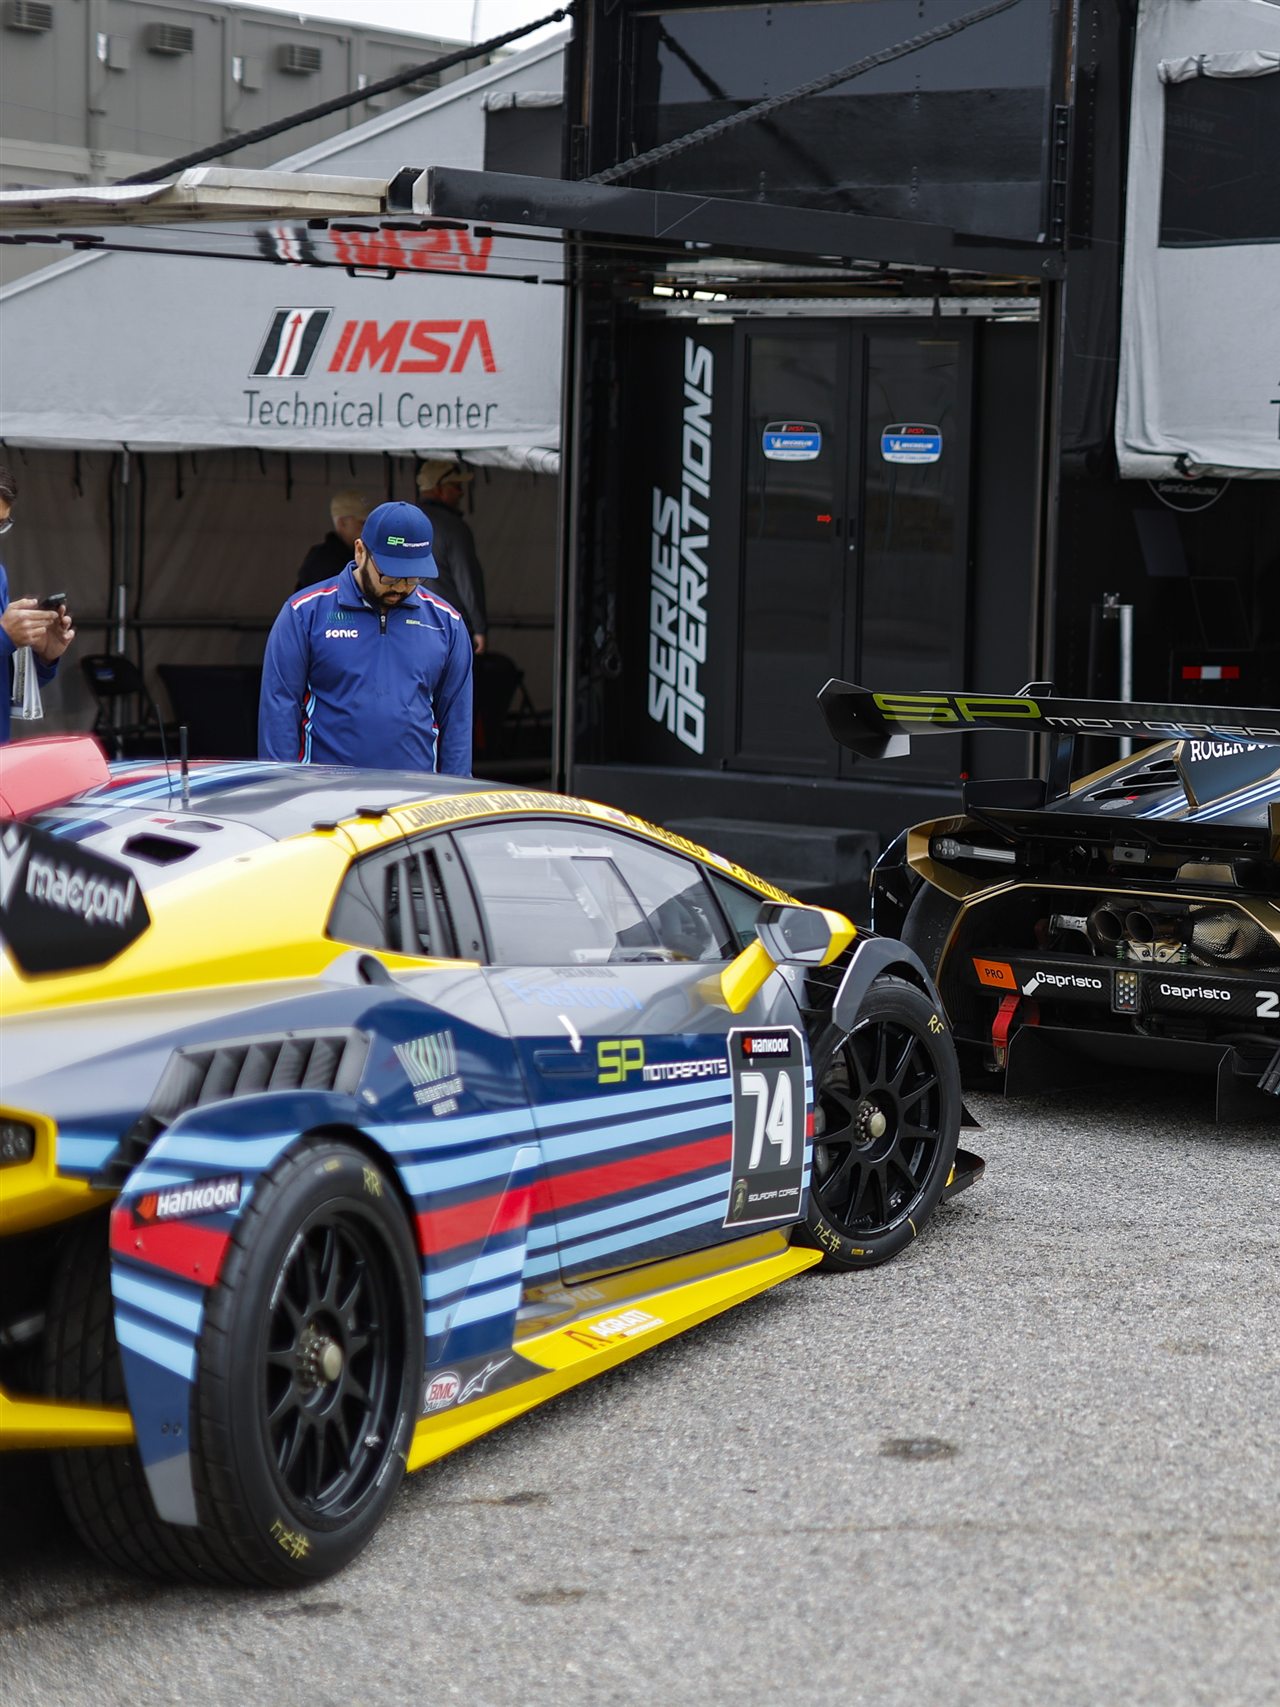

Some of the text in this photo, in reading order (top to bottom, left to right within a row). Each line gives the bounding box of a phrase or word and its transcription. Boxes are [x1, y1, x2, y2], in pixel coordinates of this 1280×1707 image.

[327, 319, 497, 373] IMSA
[243, 390, 498, 429] Technical Center
[387, 536, 404, 546] SP
[676, 336, 715, 756] OPERATIONS
[648, 486, 681, 734] SERIES
[872, 693, 1042, 723] SP
[401, 792, 591, 827] LAMBORGHINI SAN FRANCISCO
[984, 967, 1004, 980] PRO
[1035, 971, 1102, 989] Capristo
[502, 978, 643, 1010] Fastron
[1160, 983, 1231, 1001] Capristo
[927, 1014, 945, 1034] RF
[597, 1039, 728, 1084] SP MOTORSPORTS
[740, 1070, 792, 1169] 74
[362, 1166, 383, 1197] RR
[588, 1309, 654, 1337] AGRATI
[428, 1381, 458, 1402] BMC
